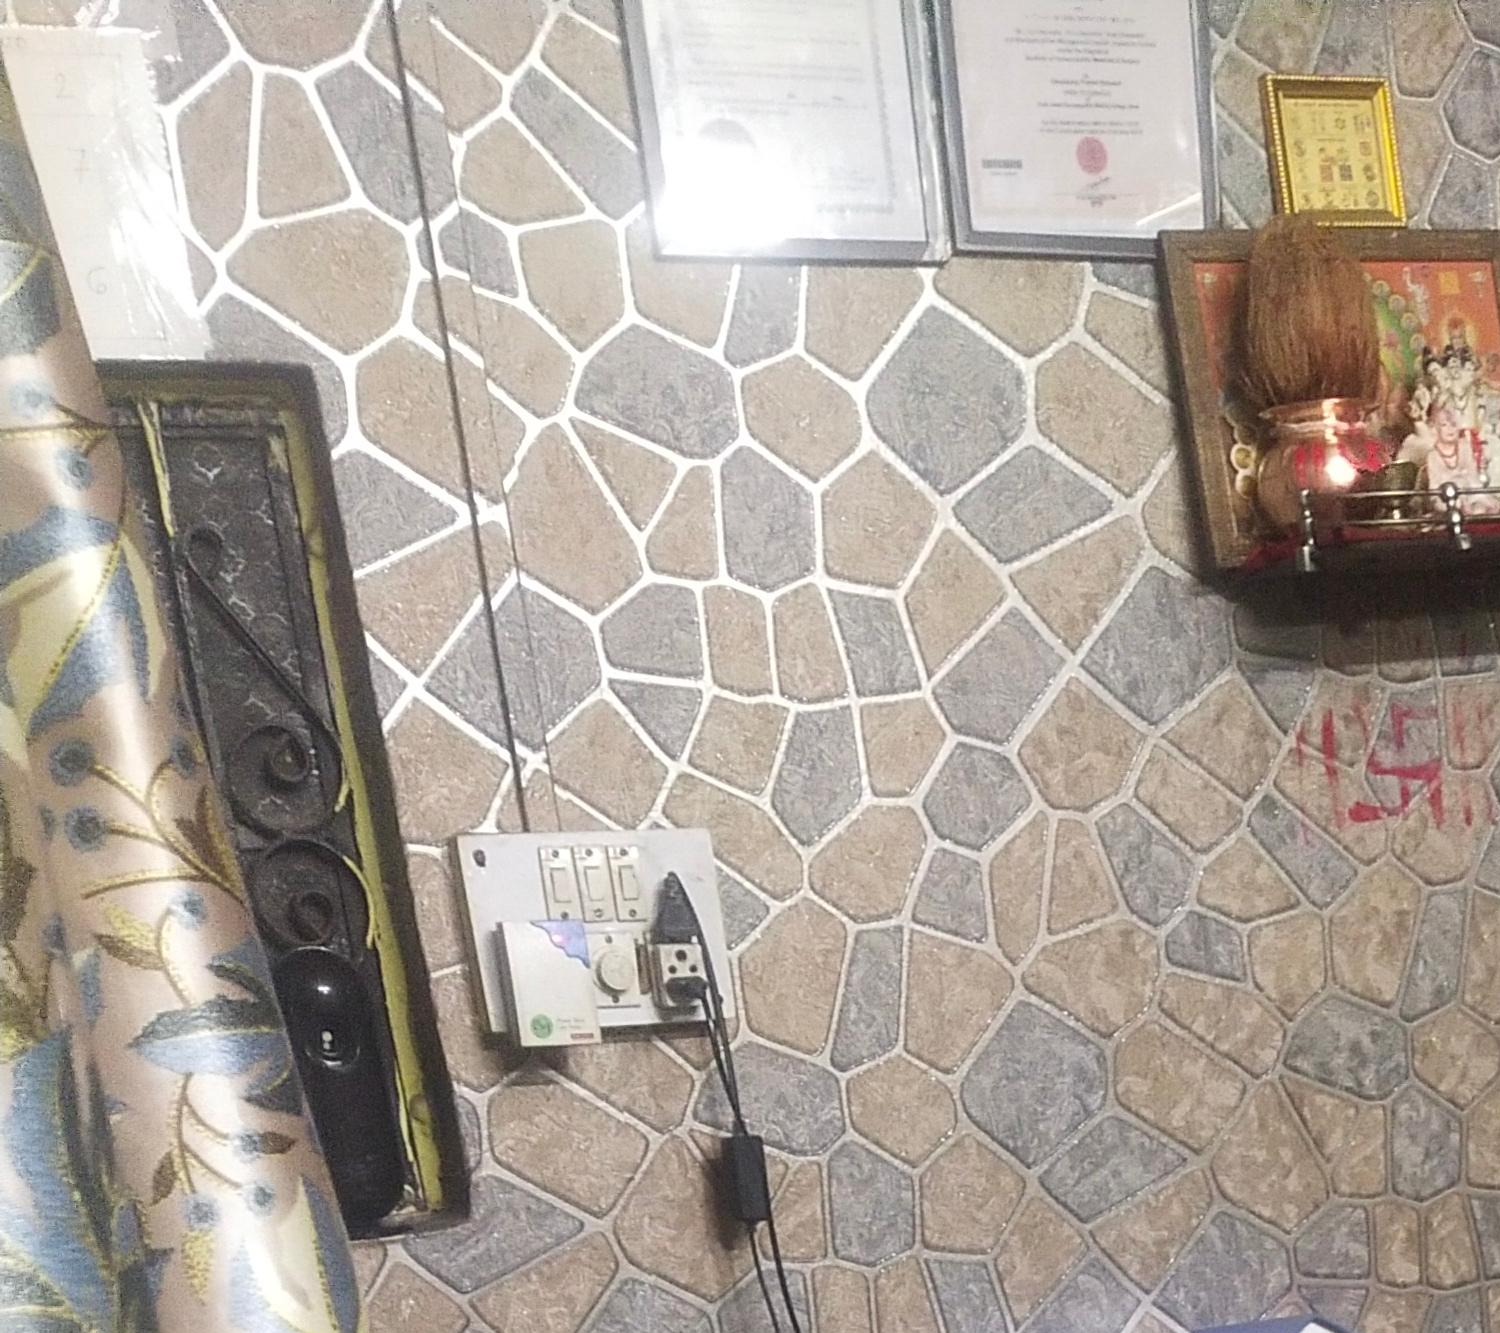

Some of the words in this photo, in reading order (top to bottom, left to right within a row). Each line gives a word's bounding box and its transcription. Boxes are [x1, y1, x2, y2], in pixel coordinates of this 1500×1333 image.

[55, 72, 75, 98] 2
[67, 147, 90, 184] 7
[86, 265, 108, 295] 6
